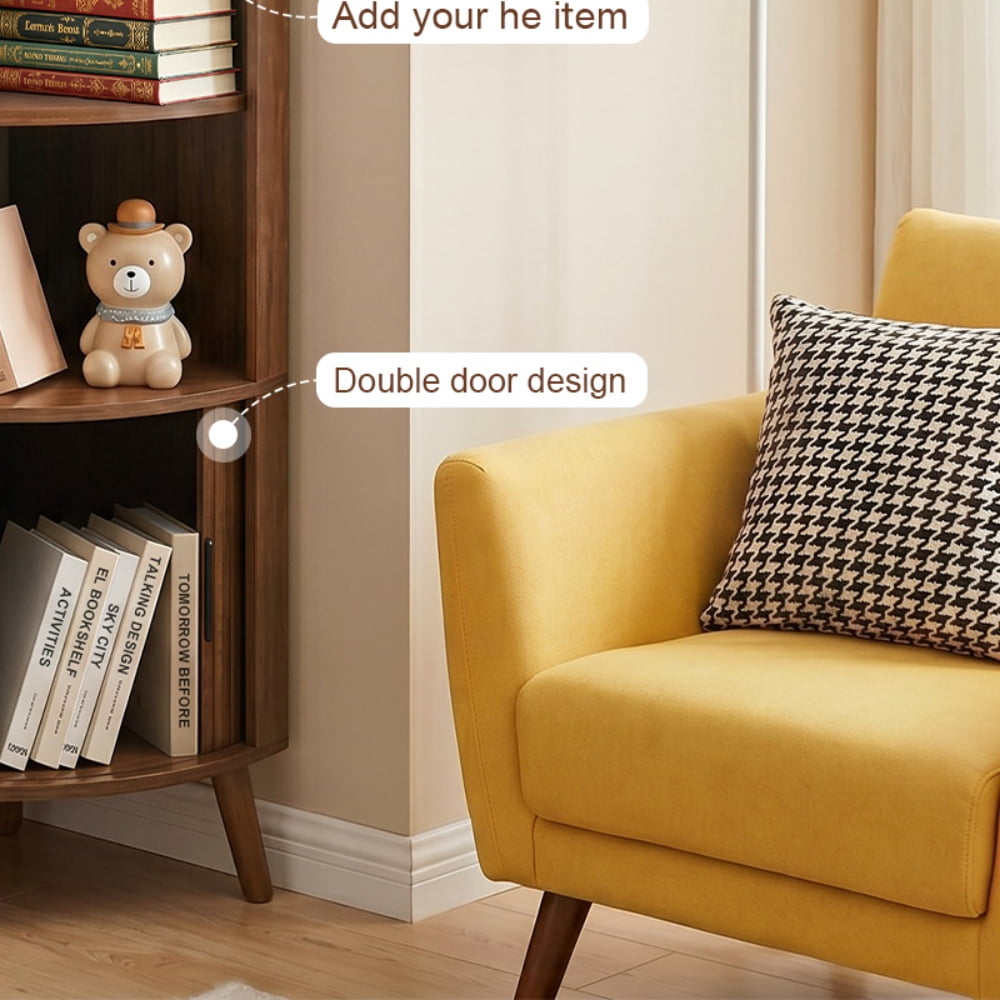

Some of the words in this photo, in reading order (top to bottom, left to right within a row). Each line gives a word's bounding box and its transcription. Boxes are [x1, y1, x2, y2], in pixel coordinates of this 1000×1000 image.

[93, 567, 109, 584] EL
[134, 556, 162, 618] TALKING
[39, 587, 72, 668] ACTIVITIES
[66, 589, 102, 679] BOOKSHELF
[102, 603, 120, 634] SKY
[117, 620, 143, 675] DESIGN
[178, 573, 191, 663] TOMORROW
[90, 636, 109, 669] CITY
[178, 667, 191, 729] BEFORE
